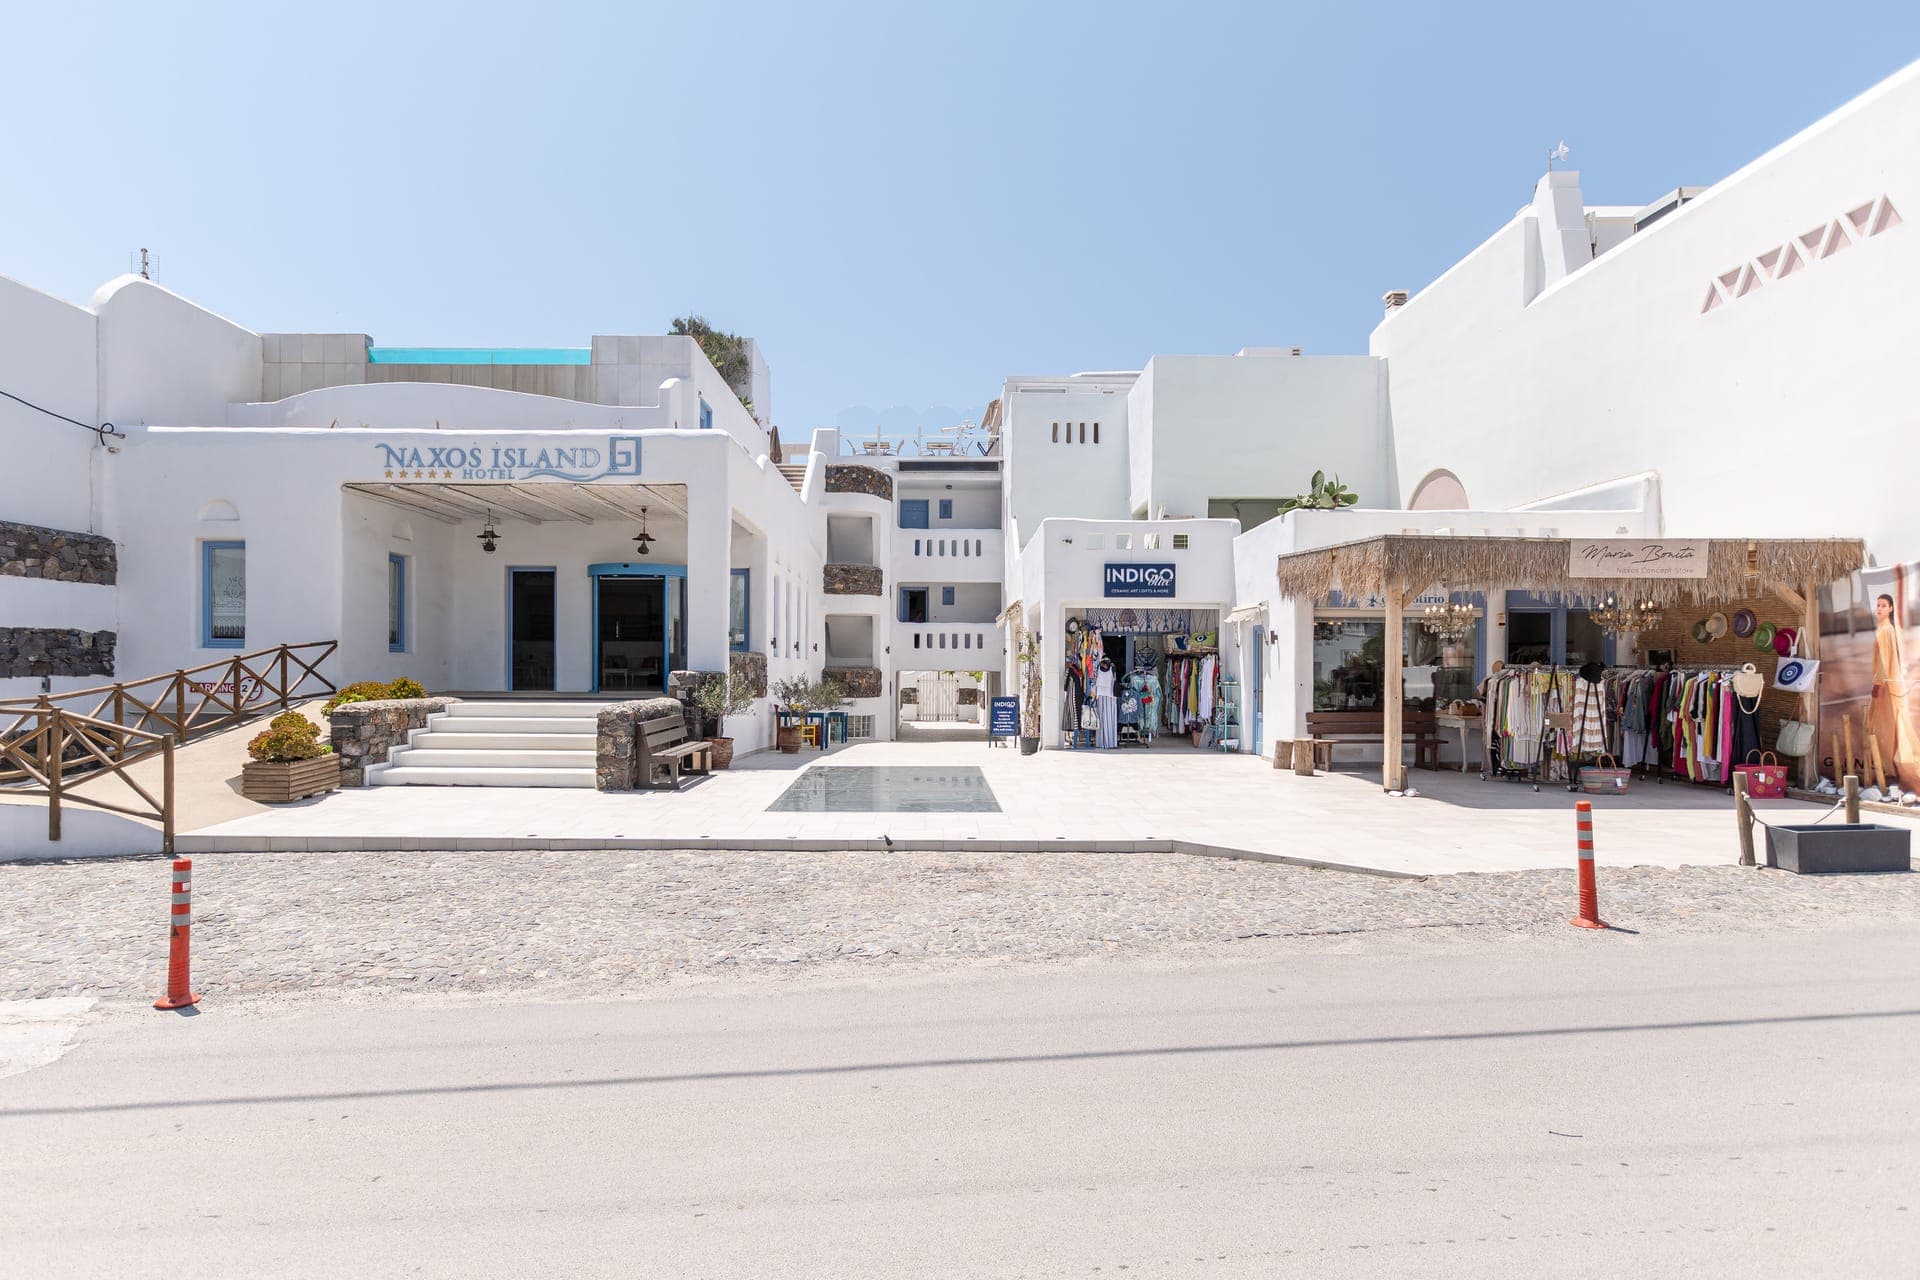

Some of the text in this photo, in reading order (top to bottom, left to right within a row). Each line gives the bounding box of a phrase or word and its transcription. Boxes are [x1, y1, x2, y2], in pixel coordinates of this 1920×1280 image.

[375, 443, 601, 468] NAXOS ISLAND
[462, 468, 515, 480] HOTEL
[1581, 544, 1696, 567] Maria Bonita
[1106, 568, 1174, 583] INDIGO
[1640, 567, 1672, 576] Concept
